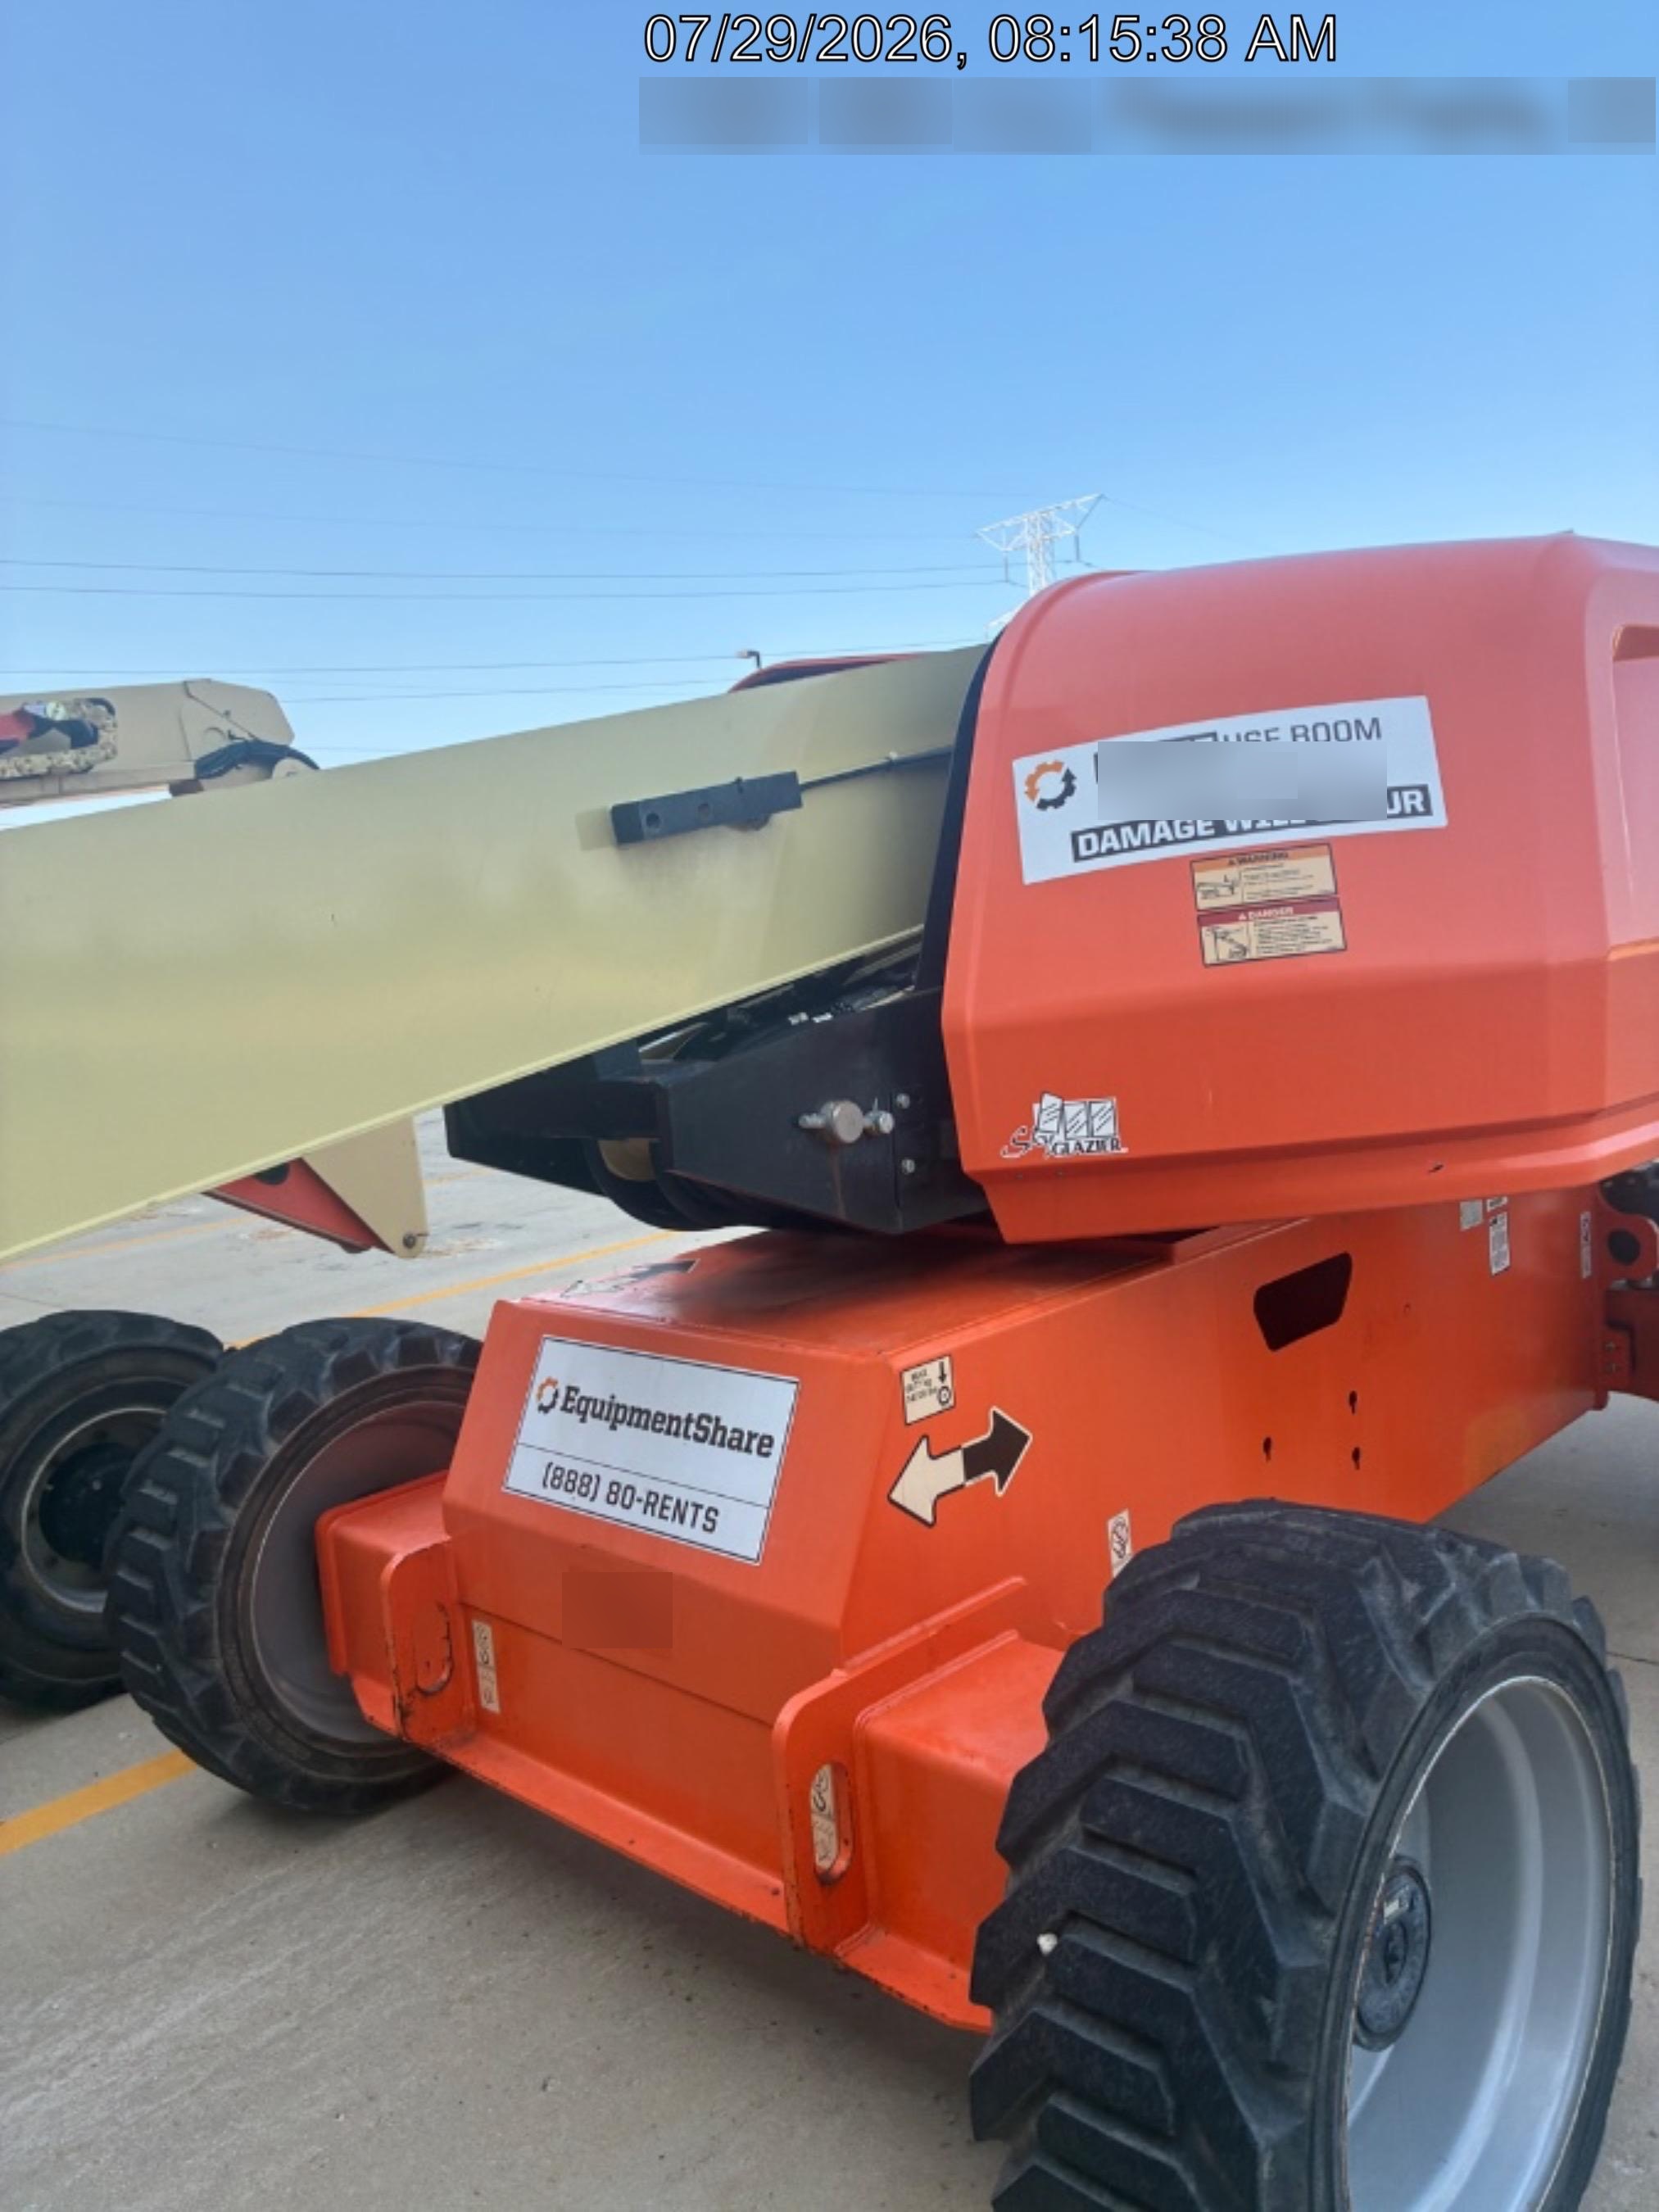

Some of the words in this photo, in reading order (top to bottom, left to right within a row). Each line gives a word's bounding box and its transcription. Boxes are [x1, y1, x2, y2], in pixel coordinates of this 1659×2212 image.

[1077, 820, 1215, 857] DAMAGE
[560, 1385, 775, 1458] EquipmentShare
[542, 1461, 600, 1502] (888)
[606, 1480, 720, 1534] 80-RENTS
